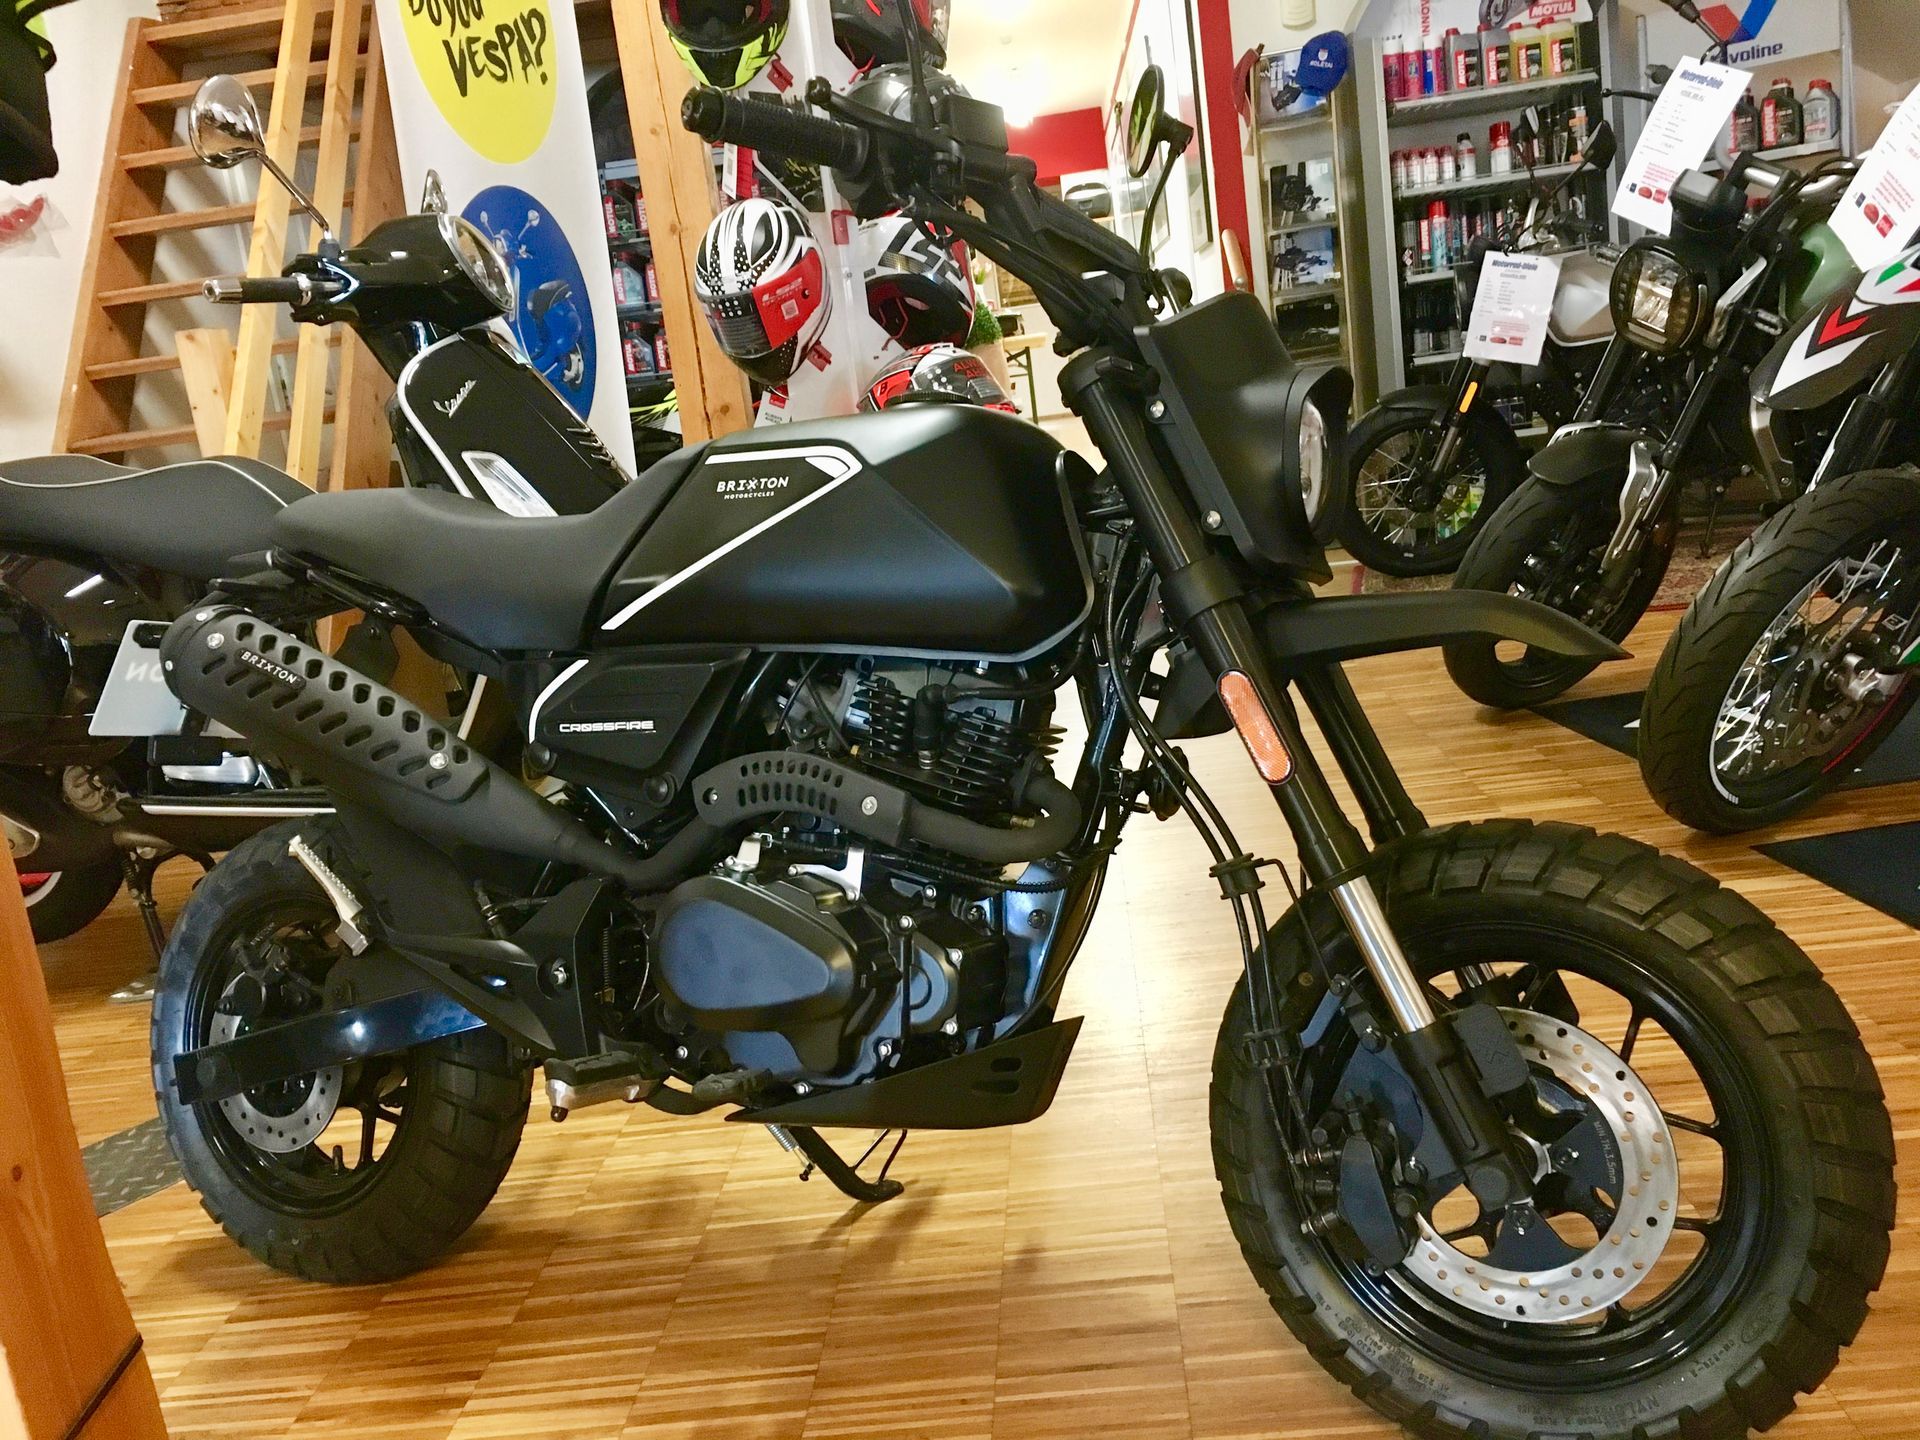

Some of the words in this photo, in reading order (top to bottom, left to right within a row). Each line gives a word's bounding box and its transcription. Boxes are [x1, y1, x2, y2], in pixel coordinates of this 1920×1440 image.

[1532, 2, 1574, 18] MOTUL
[442, 8, 549, 98] VESPA?
[1488, 50, 1497, 81] MOTUL
[1519, 47, 1528, 79] MOTUL
[1552, 42, 1562, 73] MOTUL
[1729, 43, 1783, 64] voline
[1457, 54, 1466, 84] MOTUL
[605, 203, 616, 234] MOTUL
[614, 272, 625, 302] MOTUL
[647, 269, 658, 298] MOTUL
[624, 343, 635, 371] MOTUL
[655, 340, 667, 368] MOTUL
[716, 476, 789, 492] BRIXTON
[724, 490, 775, 500] MOTORCYCLES
[240, 650, 298, 684] BRIXTON
